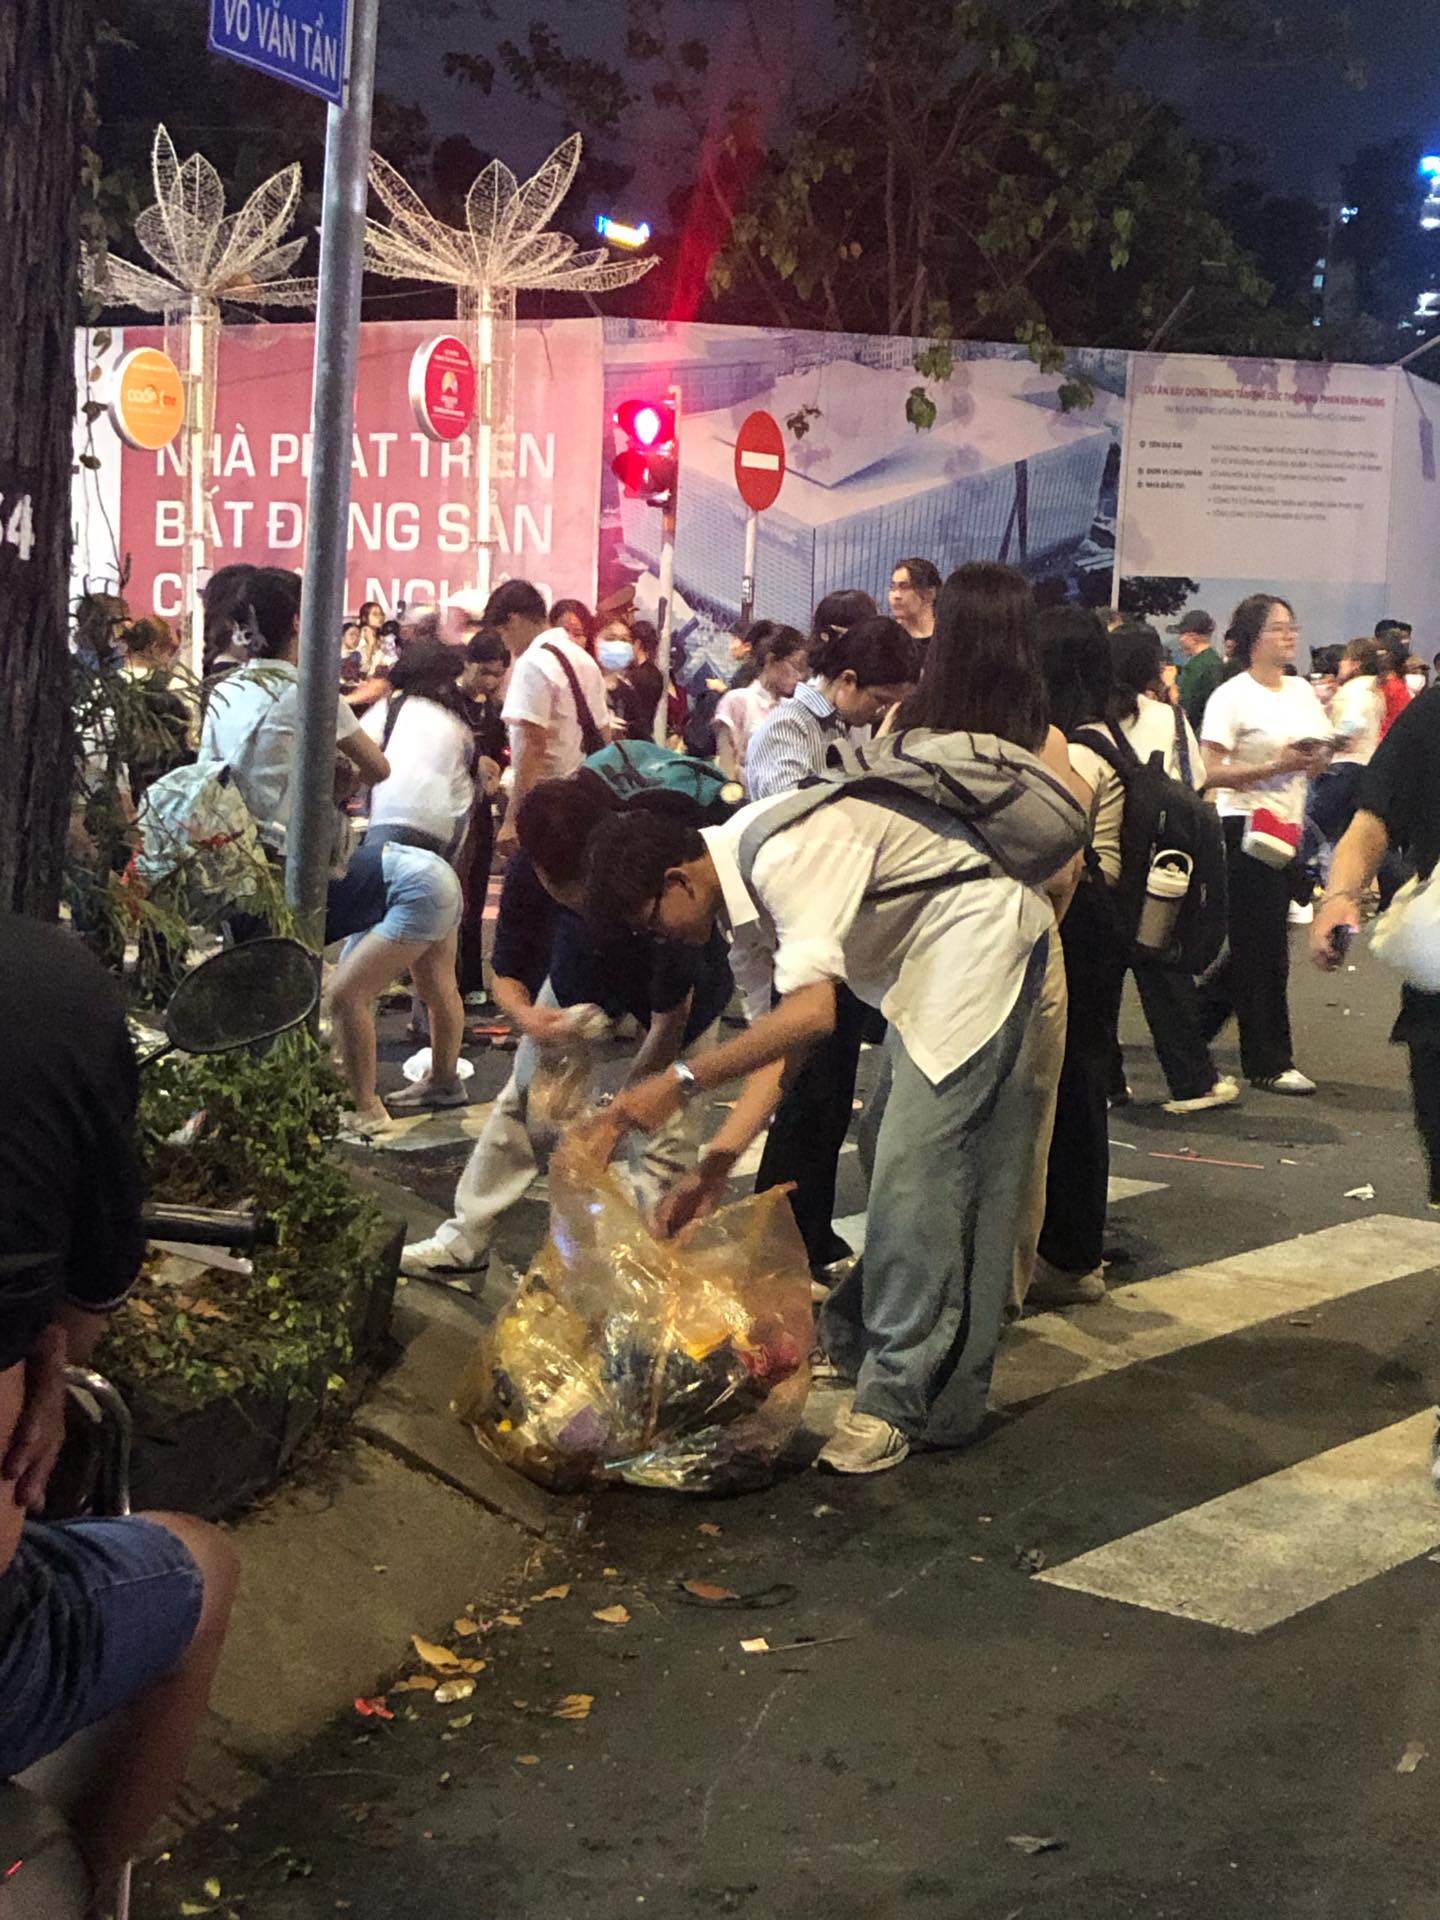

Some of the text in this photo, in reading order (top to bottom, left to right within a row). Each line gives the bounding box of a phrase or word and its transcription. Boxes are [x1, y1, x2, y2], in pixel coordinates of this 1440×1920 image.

[256, 0, 297, 63] VĂN
[301, 11, 338, 81] TẤN
[266, 501, 421, 551] ĐNG
